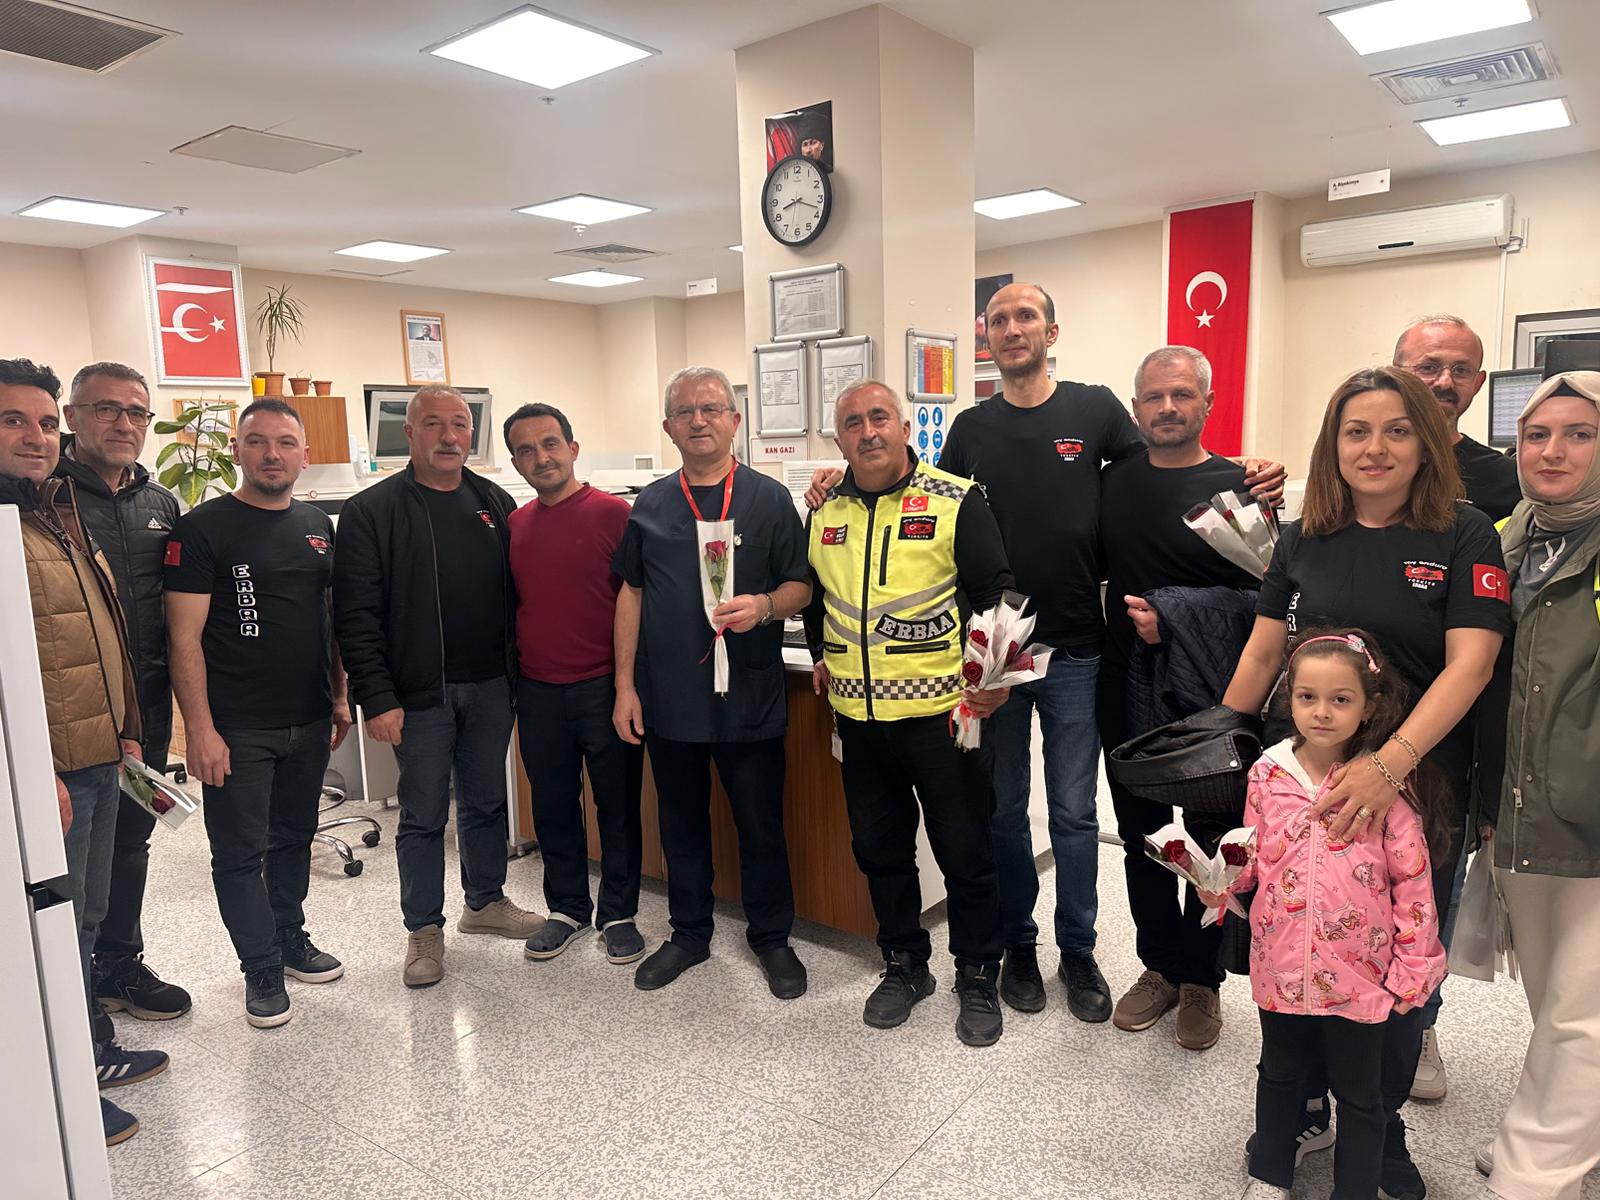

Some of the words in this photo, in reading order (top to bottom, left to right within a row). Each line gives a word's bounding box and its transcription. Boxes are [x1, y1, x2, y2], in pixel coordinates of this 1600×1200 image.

[794, 166, 801, 174] 12
[784, 172, 789, 180] 11
[776, 184, 782, 192] 10
[813, 181, 820, 189] 2
[772, 199, 778, 207] 9
[817, 195, 823, 203] 3
[775, 214, 782, 222] 8
[784, 224, 789, 232] 7
[805, 223, 812, 231] 5
[794, 228, 801, 236] 6
[1419, 561, 1448, 570] enduro
[232, 564, 259, 637] ERBAA
[879, 615, 954, 640] ERBAA
